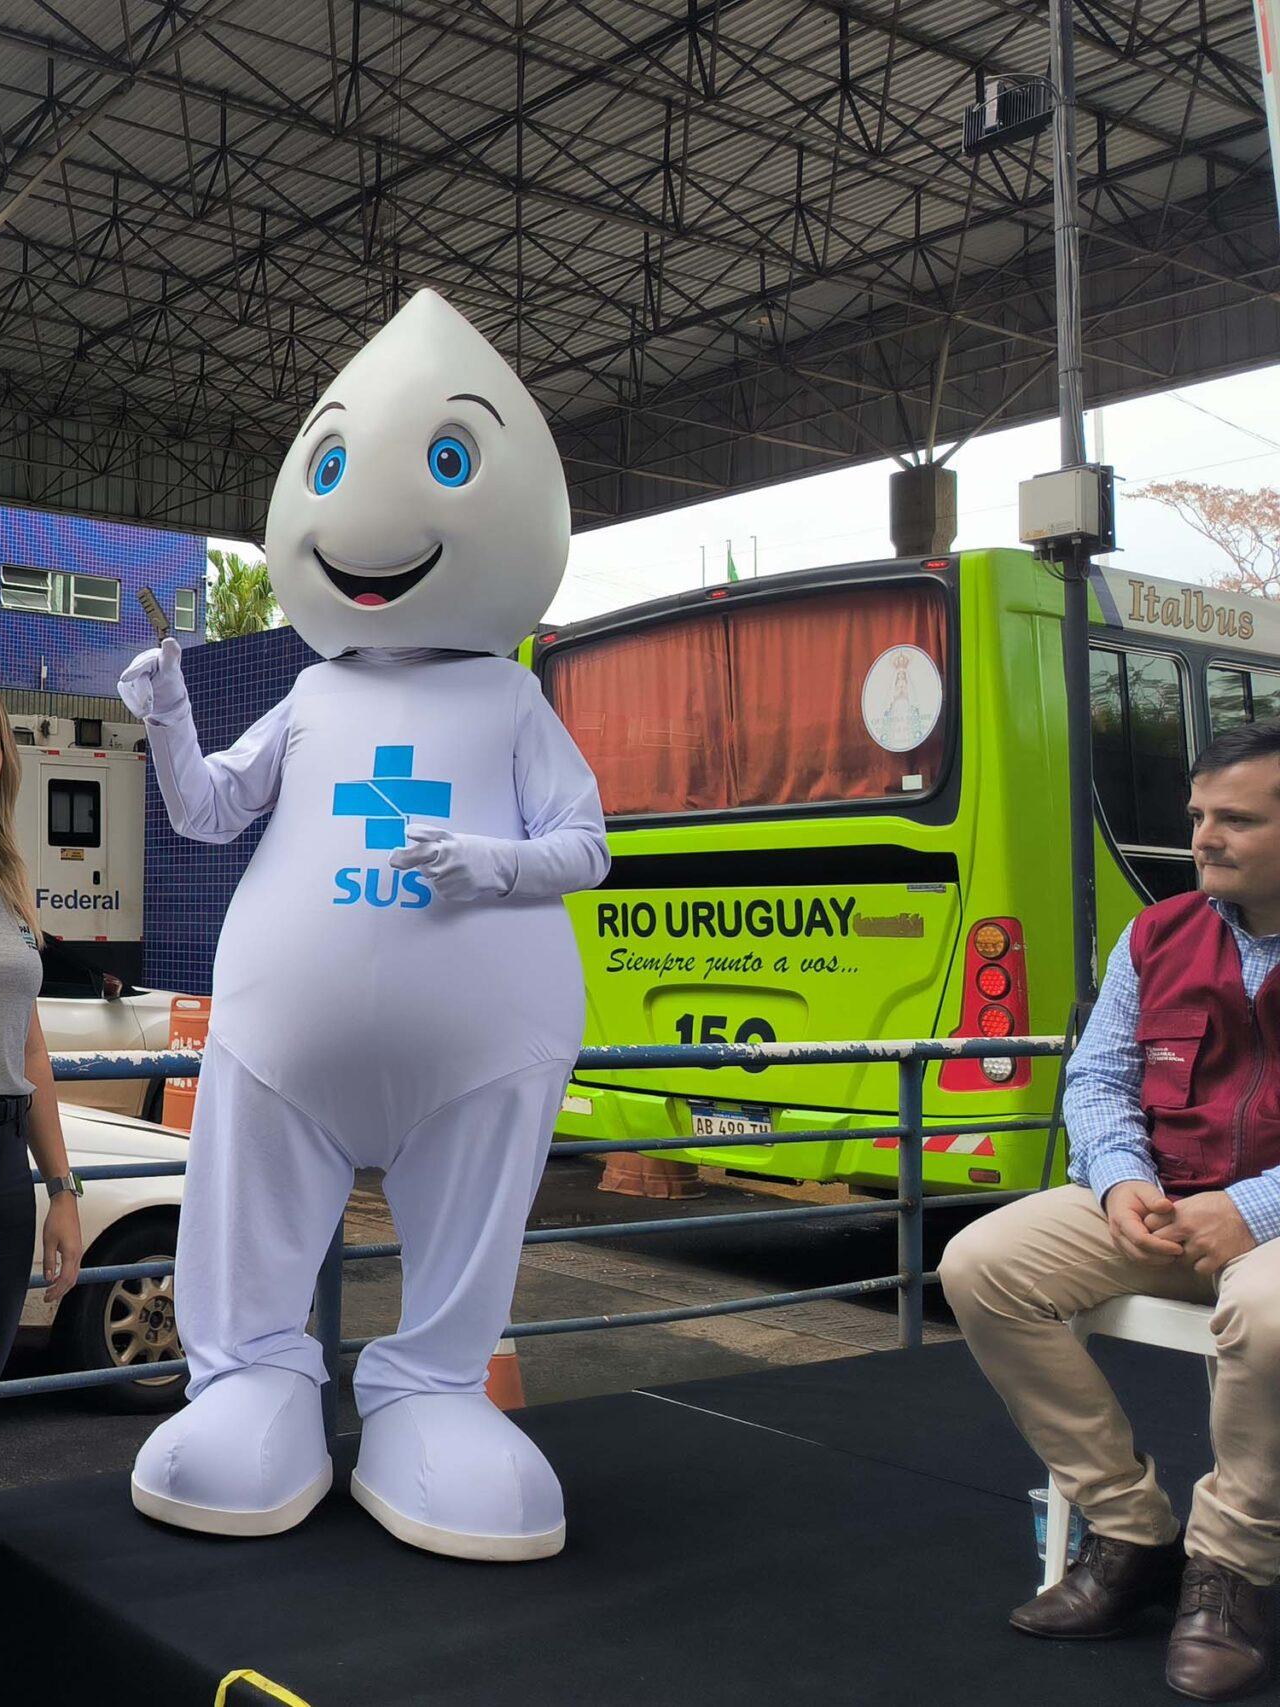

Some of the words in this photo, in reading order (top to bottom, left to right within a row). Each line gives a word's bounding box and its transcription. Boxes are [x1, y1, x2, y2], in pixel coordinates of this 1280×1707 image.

[1128, 579, 1255, 640] Italbus
[36, 888, 120, 910] Federal
[333, 867, 432, 909] SUS
[597, 902, 657, 938] RIO
[665, 896, 856, 938] URUGUAY
[606, 947, 696, 978] Siempre
[703, 950, 765, 979] junto
[773, 955, 790, 973] a
[696, 1117, 714, 1135] AB
